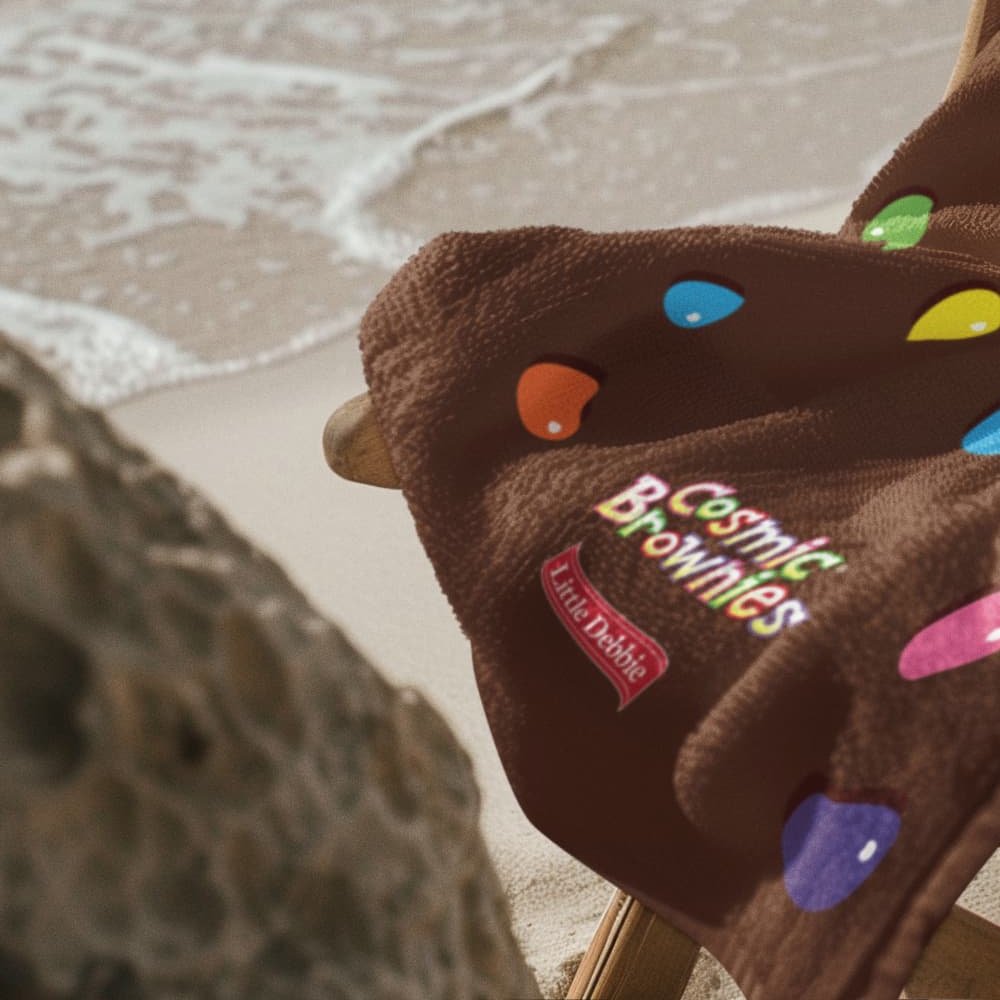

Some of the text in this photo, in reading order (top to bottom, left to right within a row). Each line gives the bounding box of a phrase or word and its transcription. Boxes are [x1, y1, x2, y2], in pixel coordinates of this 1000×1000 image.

[594, 473, 810, 637] Brownies
[669, 481, 845, 580] Cosmic
[549, 562, 647, 684] Little Debbie
